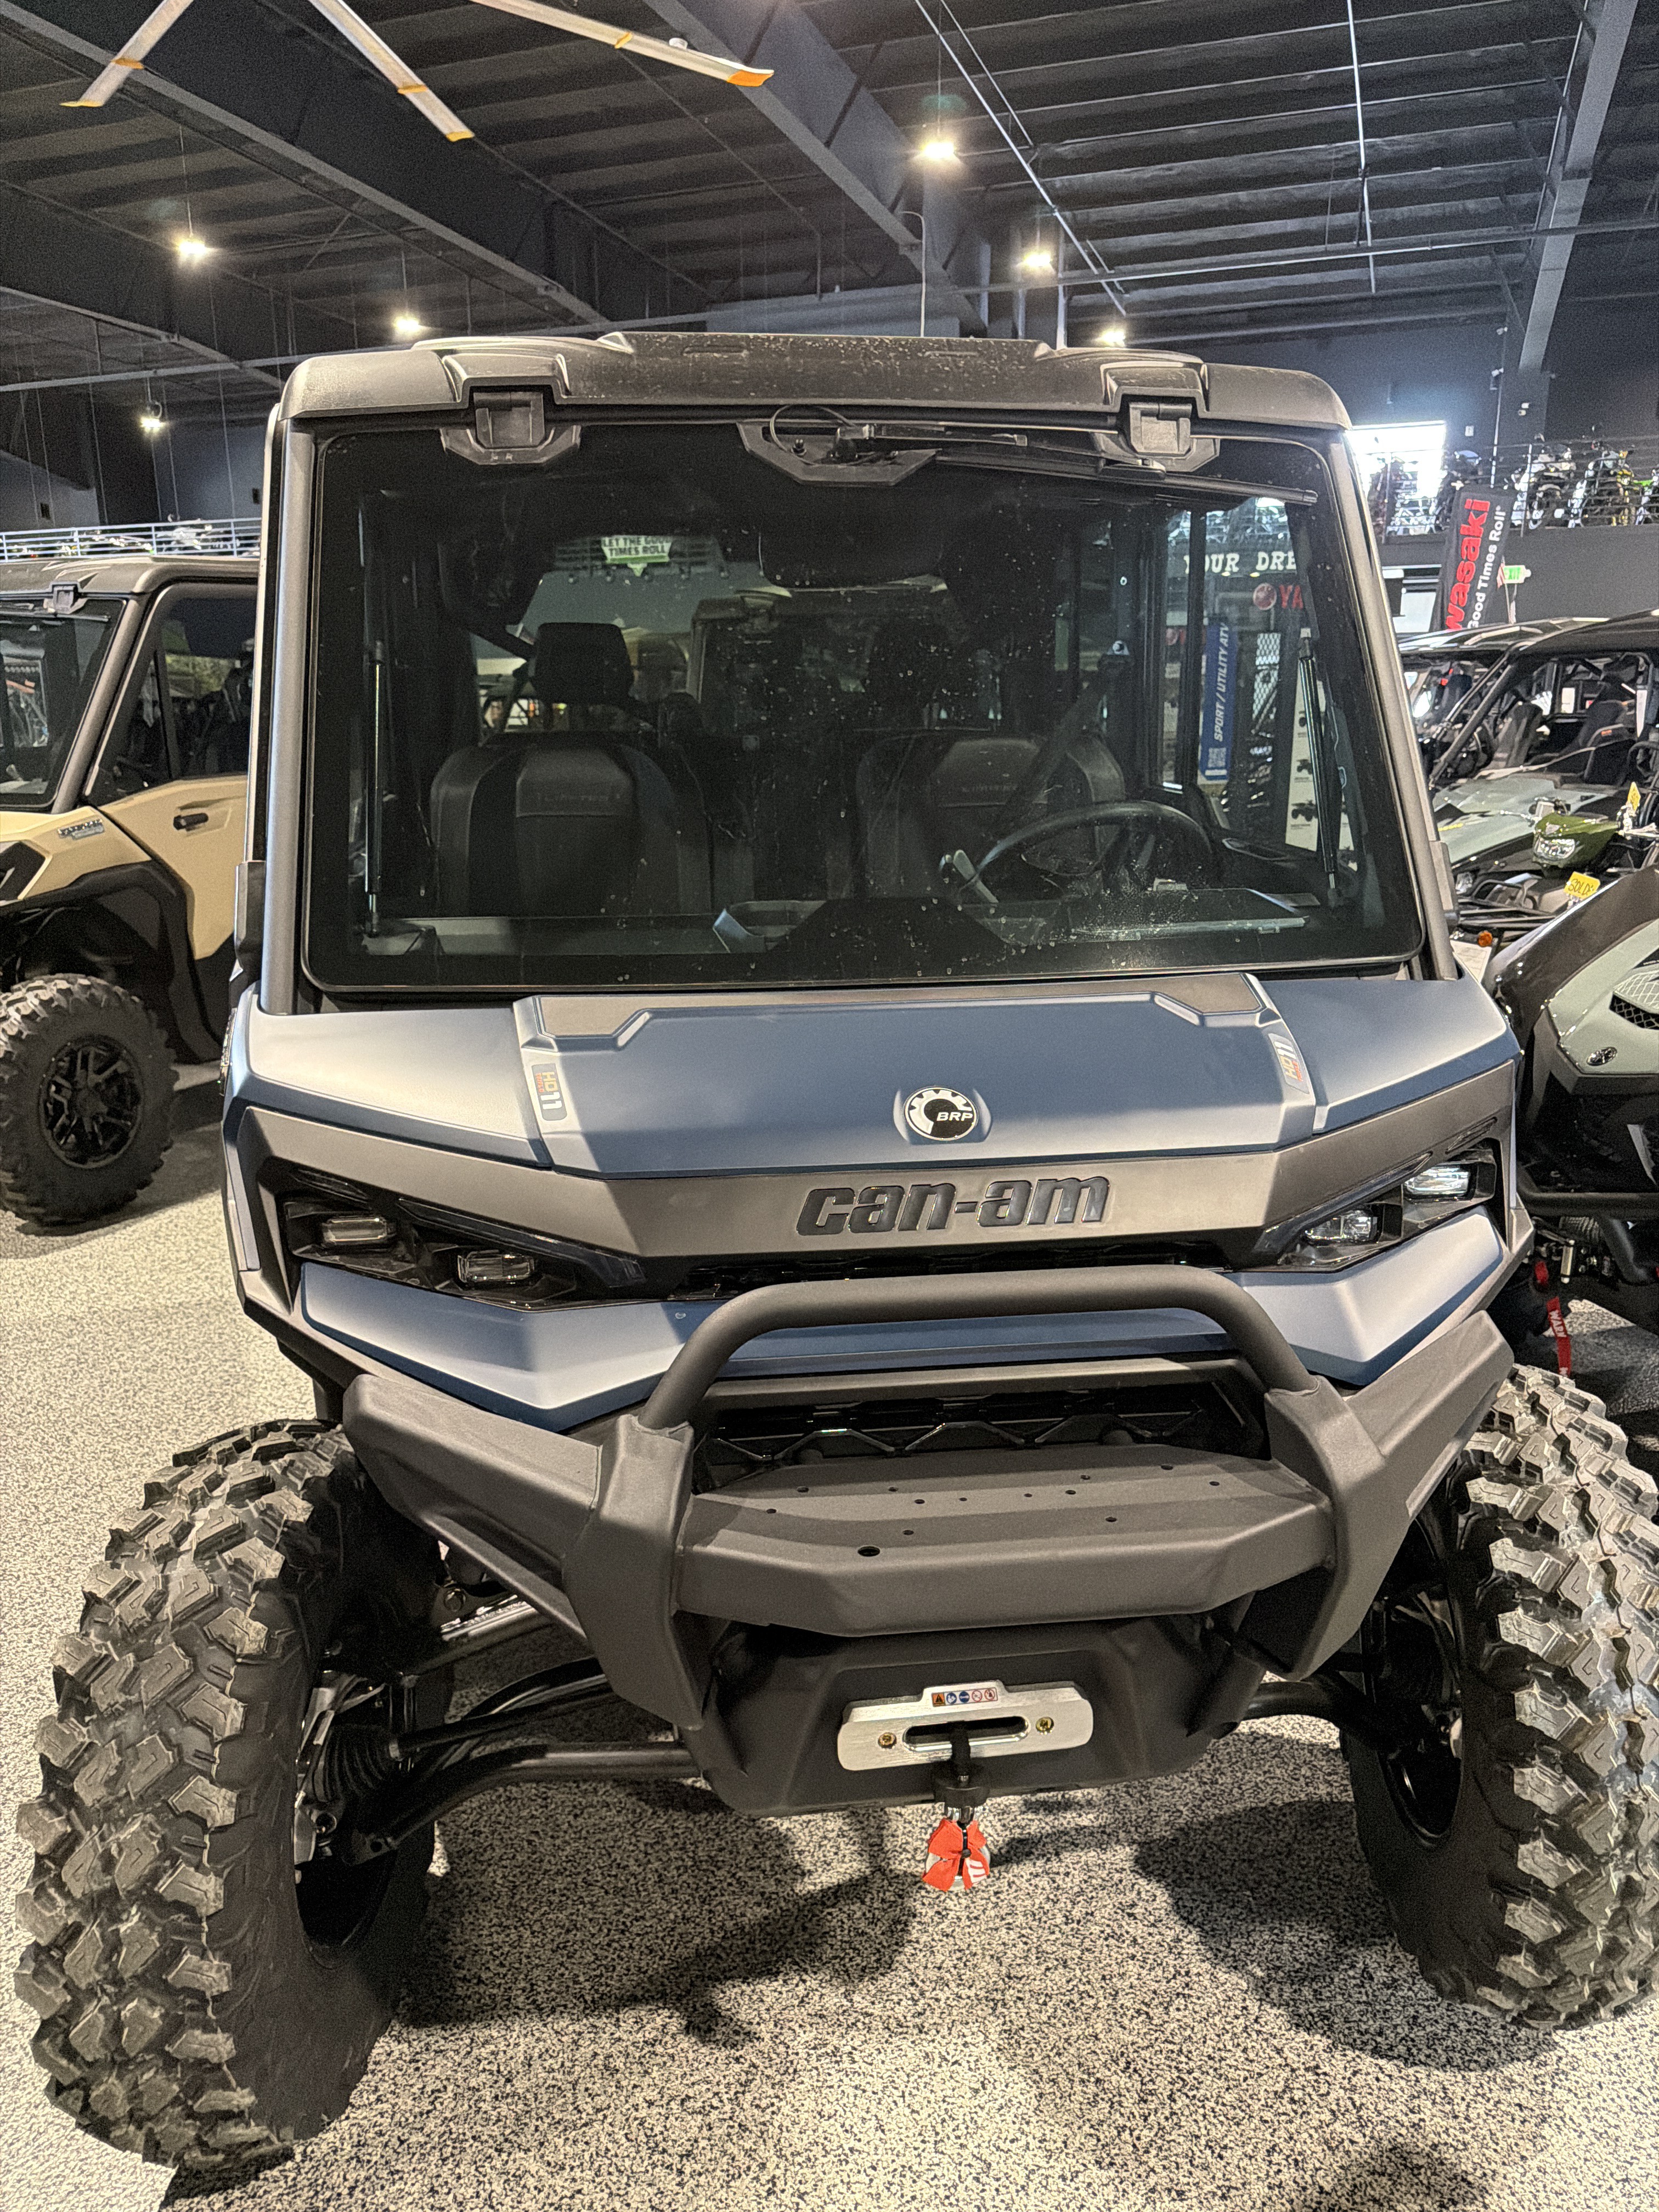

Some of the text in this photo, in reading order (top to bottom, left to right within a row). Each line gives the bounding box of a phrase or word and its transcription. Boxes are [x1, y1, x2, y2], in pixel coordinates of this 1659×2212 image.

[601, 538, 619, 547] LET
[623, 537, 641, 546] THE
[608, 545, 665, 557] TIMES ROLL
[1477, 544, 1497, 590] Times
[1504, 567, 1521, 579] EXIT
[1219, 623, 1229, 647] ATV
[1217, 647, 1228, 692] UTILITY
[1214, 702, 1224, 742] SPORT
[1273, 1041, 1298, 1080] HD11
[540, 1071, 562, 1110] HD11
[936, 1110, 974, 1122] BRP
[796, 1176, 1110, 1236] can-am
[1549, 1310, 1567, 1338] WARN
